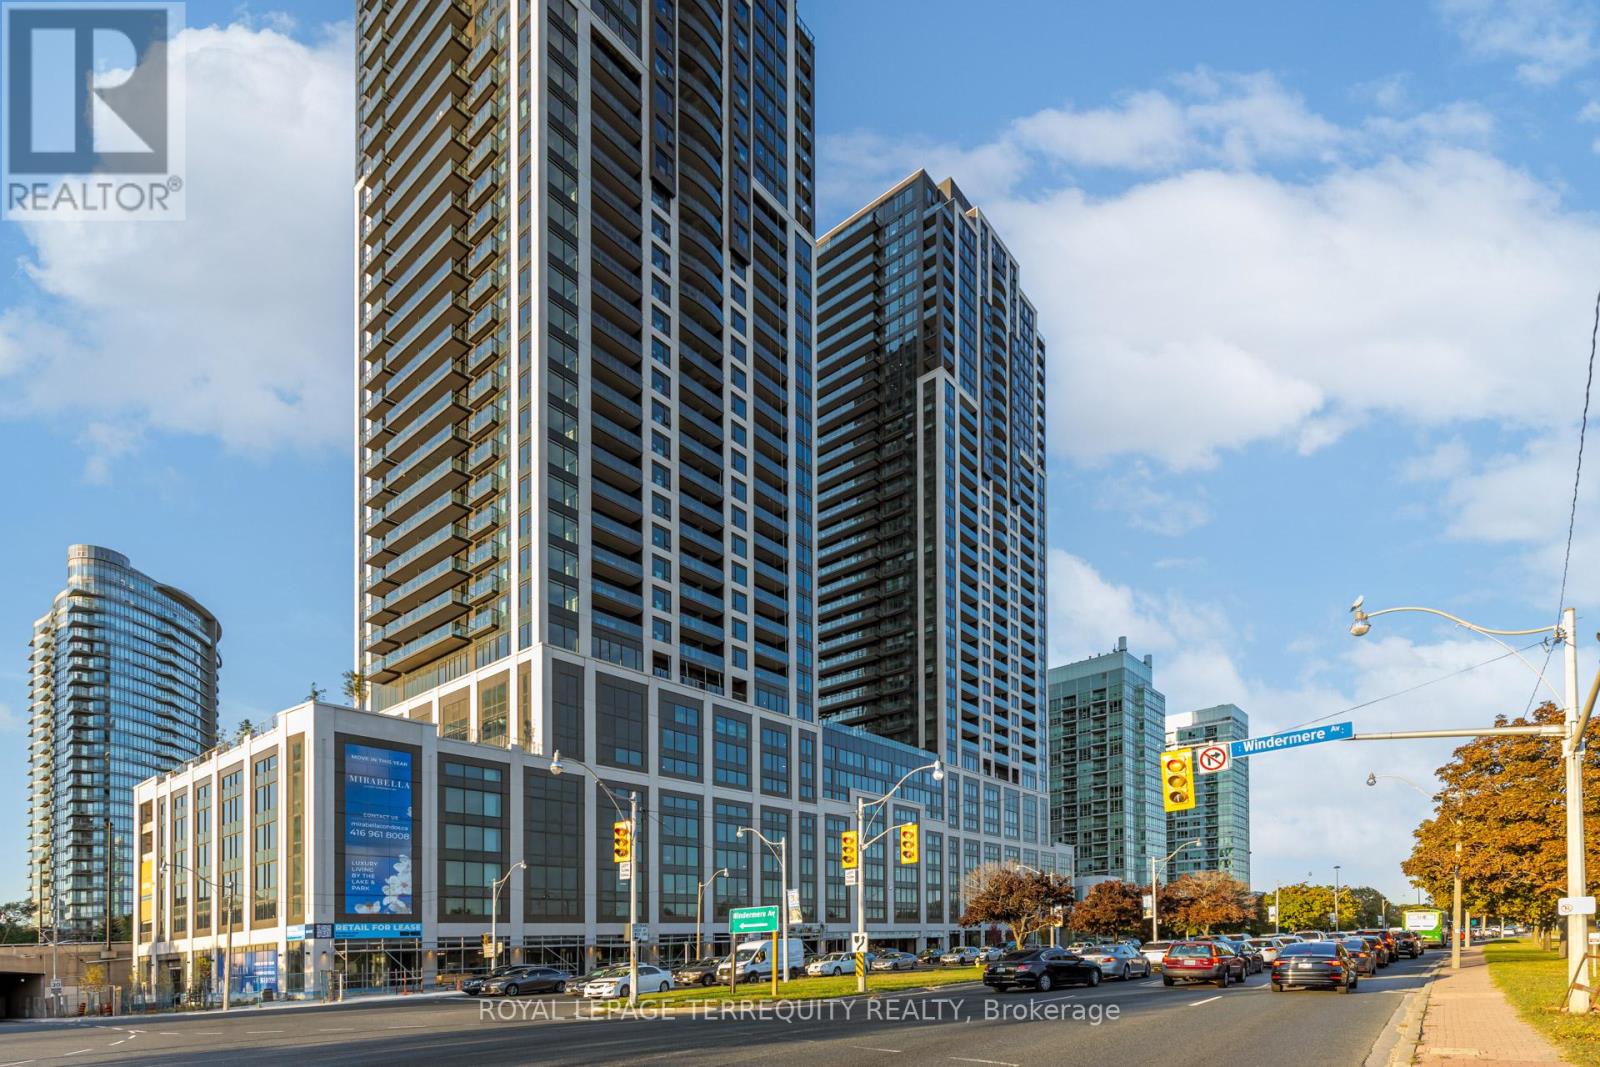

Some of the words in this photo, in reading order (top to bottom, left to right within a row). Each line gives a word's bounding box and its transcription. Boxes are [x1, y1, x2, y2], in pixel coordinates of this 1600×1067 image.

[1243, 729, 1326, 752] Windermere
[350, 774, 410, 790] MIRABELLA
[363, 812, 390, 820] CONTACT
[350, 828, 366, 837] 416
[368, 830, 384, 838] 961
[386, 831, 410, 840] 8008
[335, 923, 369, 932] RETAIL
[371, 923, 391, 932] FOR
[393, 923, 421, 932] LEASE
